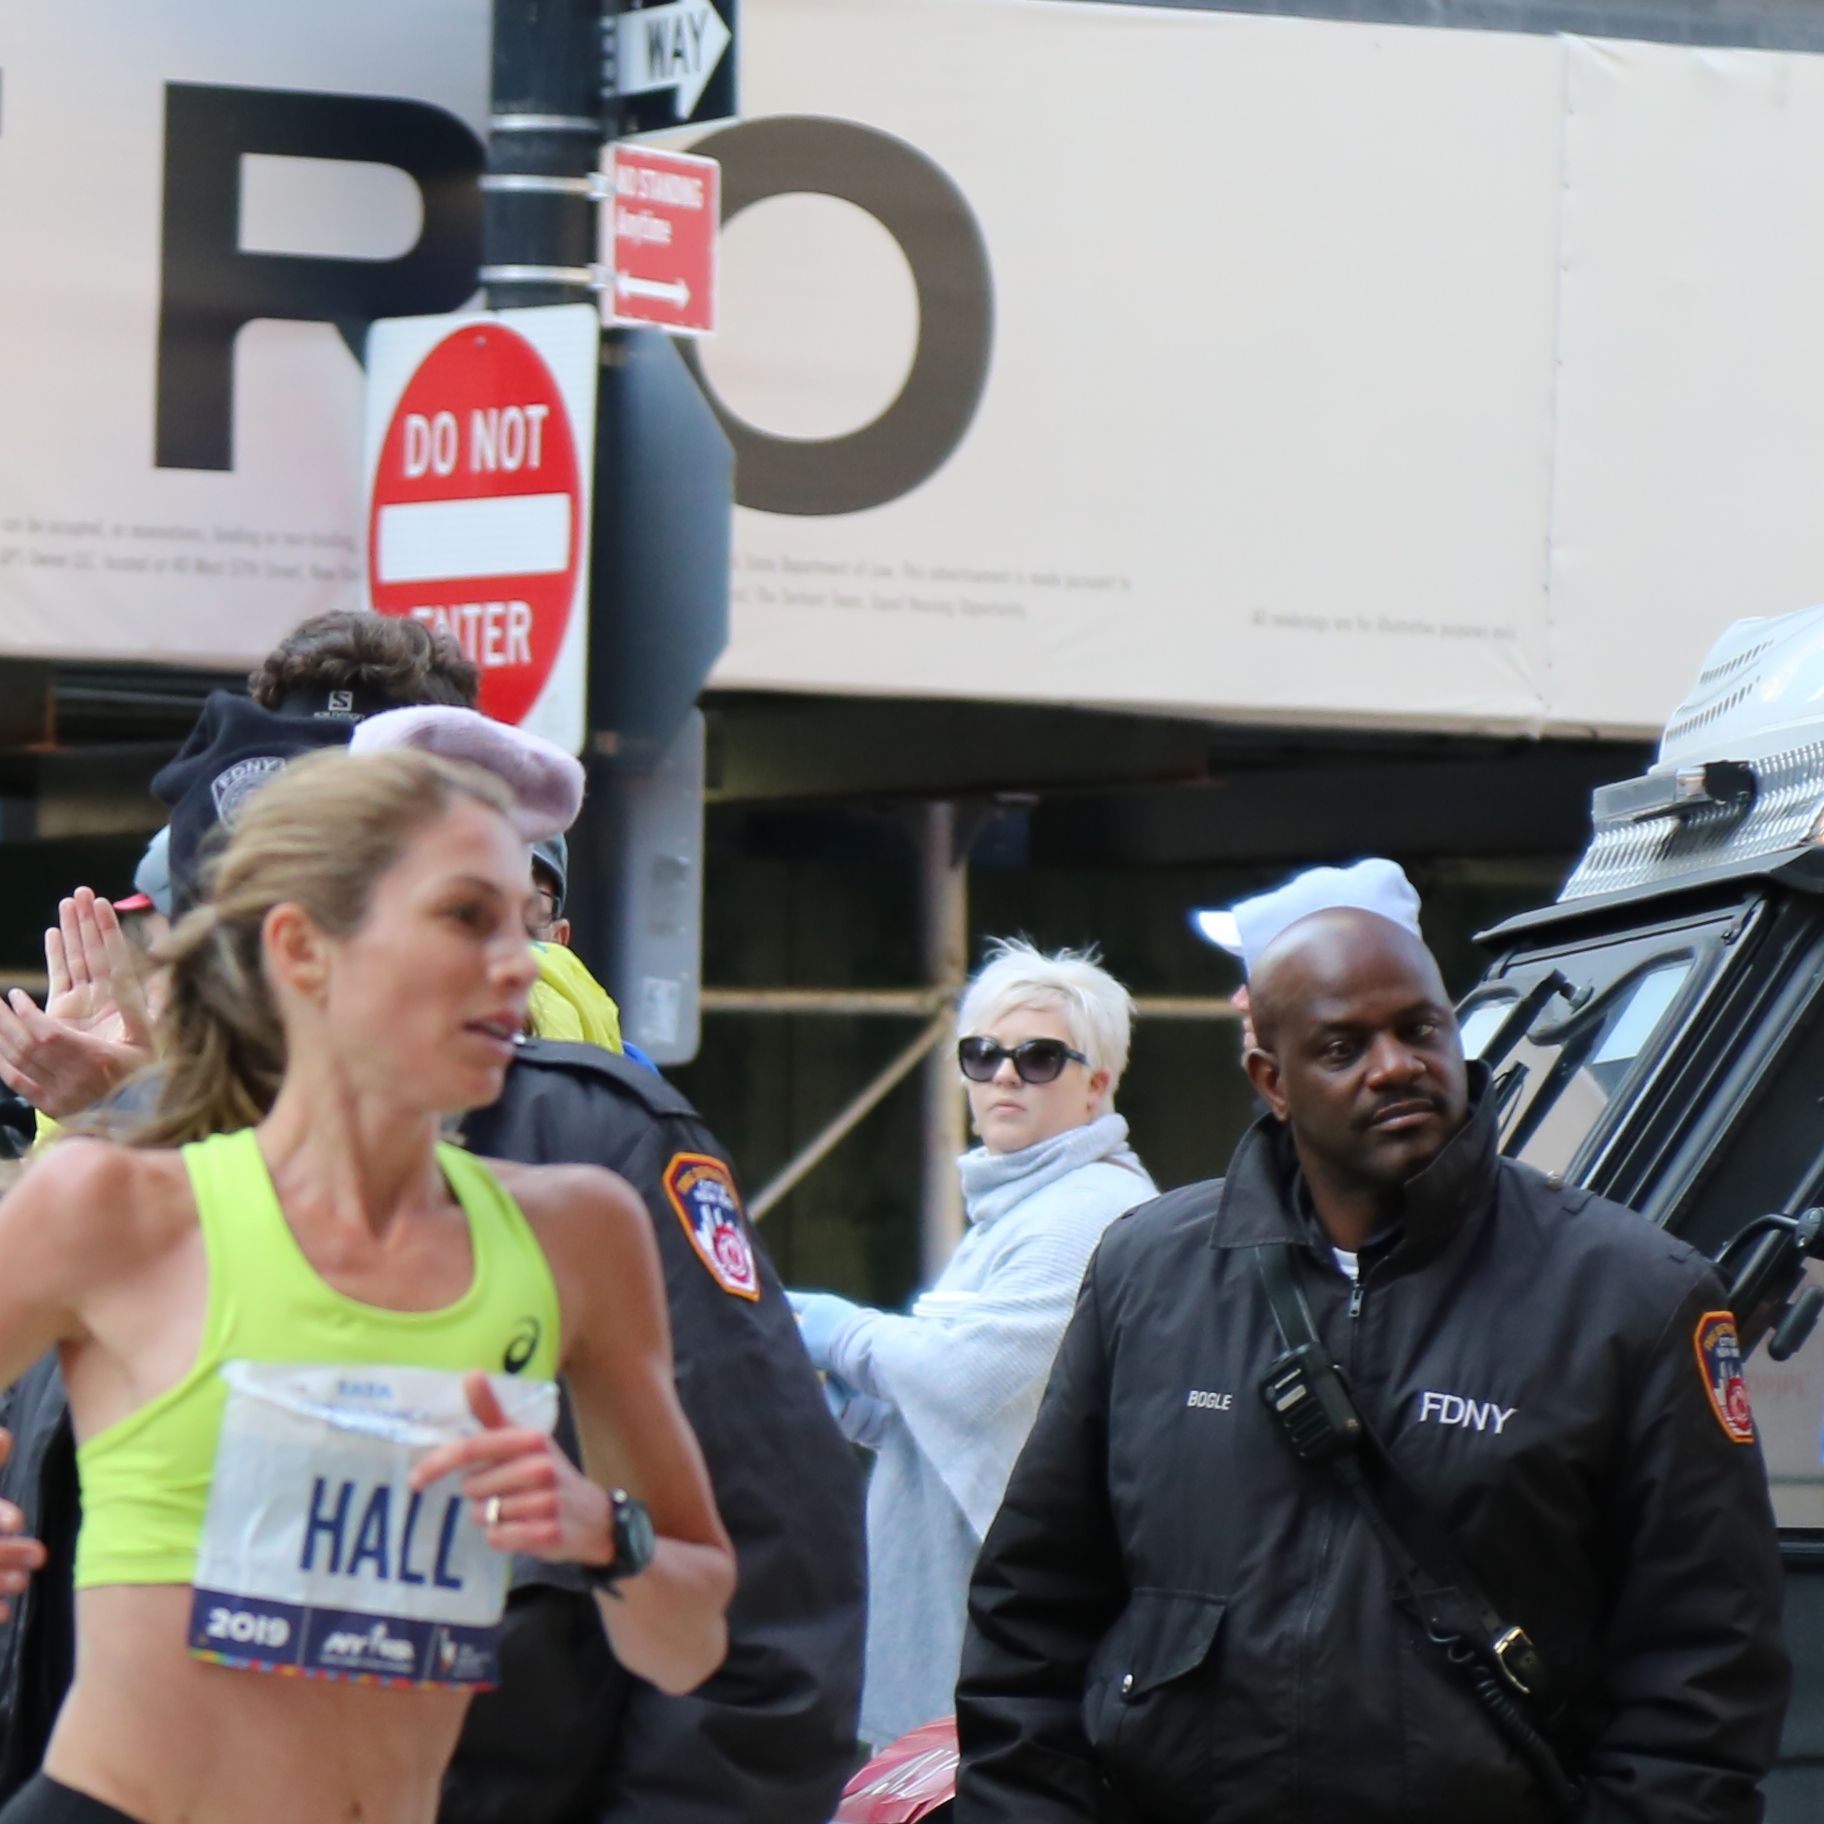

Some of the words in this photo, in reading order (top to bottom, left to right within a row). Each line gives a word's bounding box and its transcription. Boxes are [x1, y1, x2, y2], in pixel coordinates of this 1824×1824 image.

[646, 10, 707, 80] WAY
[638, 168, 704, 209] STANDING
[402, 410, 458, 479] DO
[470, 403, 550, 474] NOT
[409, 600, 533, 669] NTER
[218, 758, 278, 789] FDNY
[1187, 1390, 1233, 1411] BOGLE
[1418, 1390, 1519, 1435] FDNY
[300, 1477, 464, 1592] HALL
[206, 1607, 290, 1649] 2019
